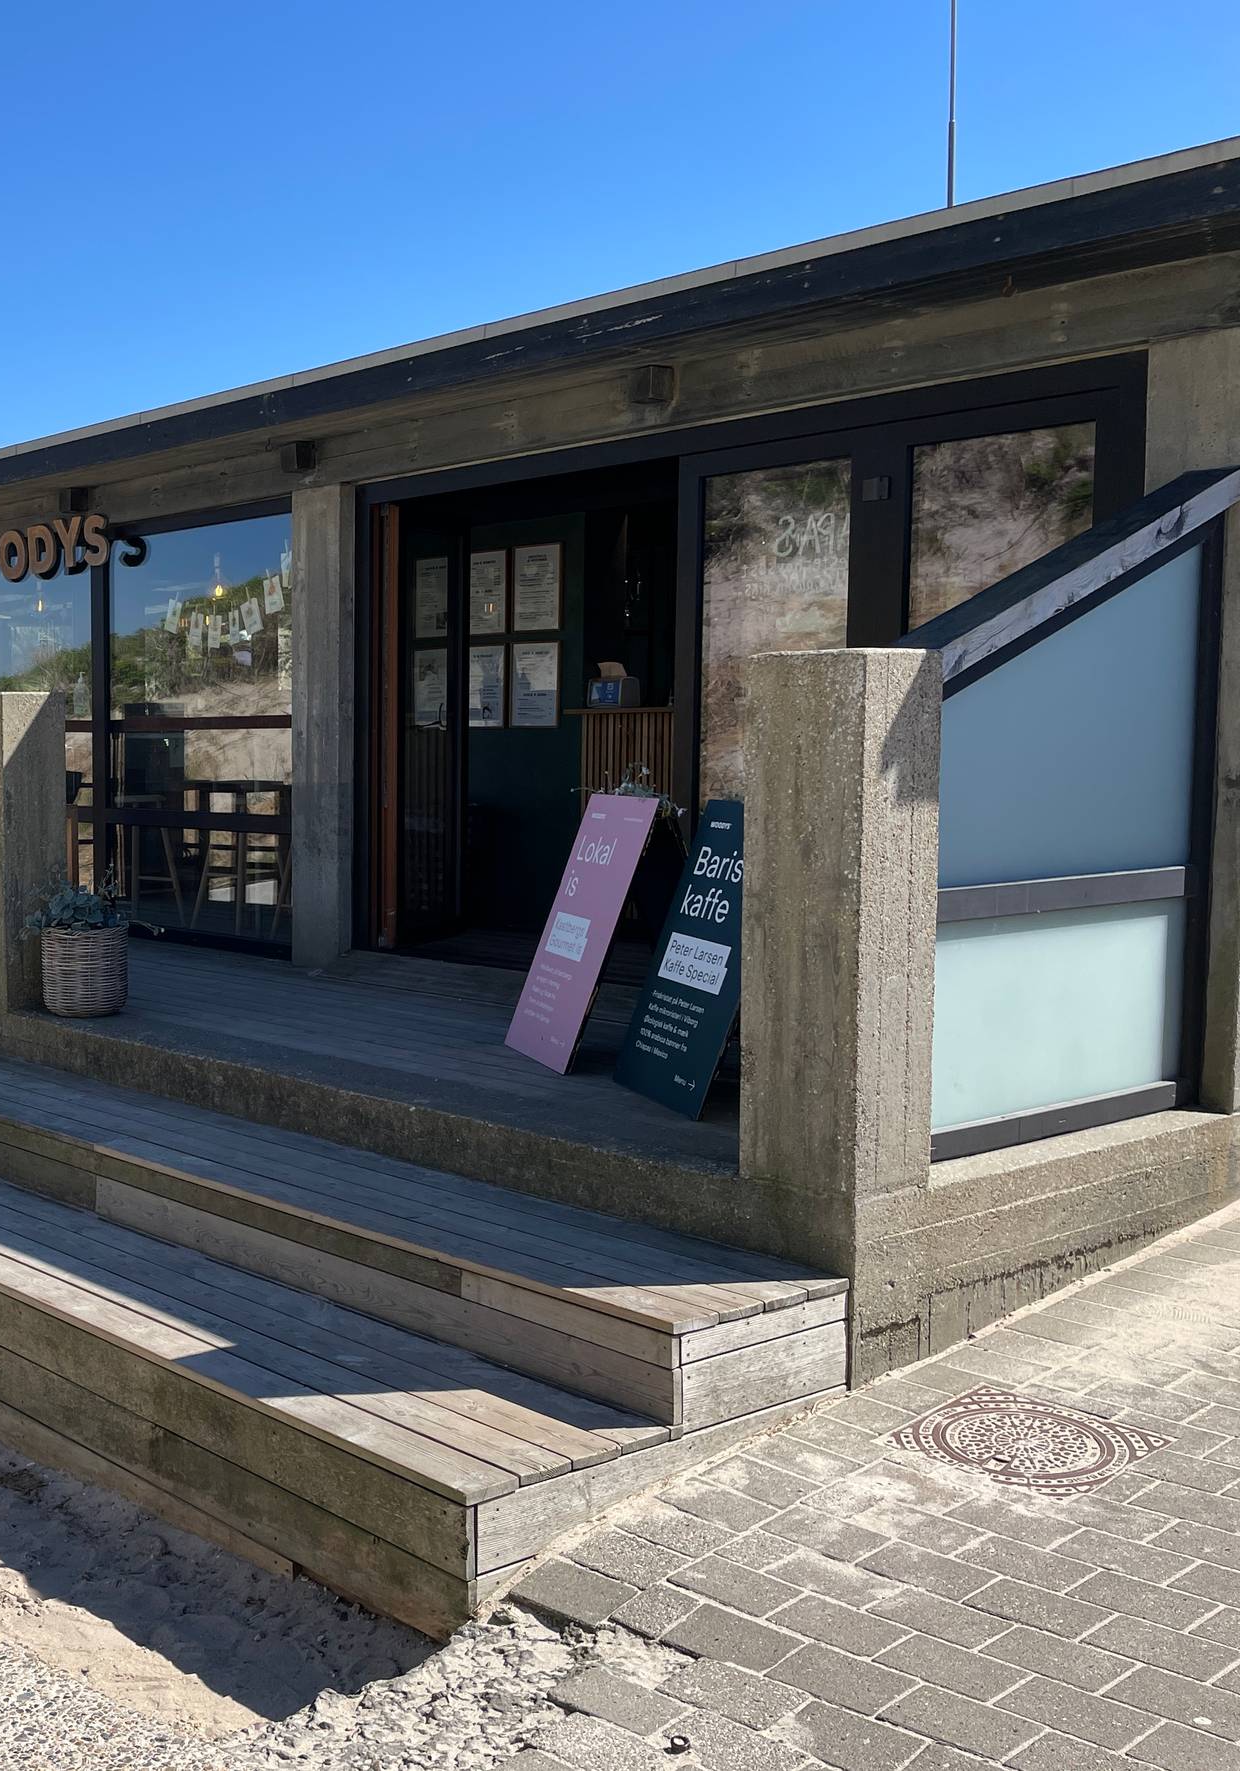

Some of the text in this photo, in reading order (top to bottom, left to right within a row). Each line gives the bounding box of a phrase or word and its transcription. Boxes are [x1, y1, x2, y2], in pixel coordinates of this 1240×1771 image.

[576, 835, 618, 866] Lokal
[565, 870, 579, 897] is
[680, 884, 730, 924] kaffe
[670, 939, 724, 966] Peter Larsen
[663, 958, 720, 985] Kaffe Special
